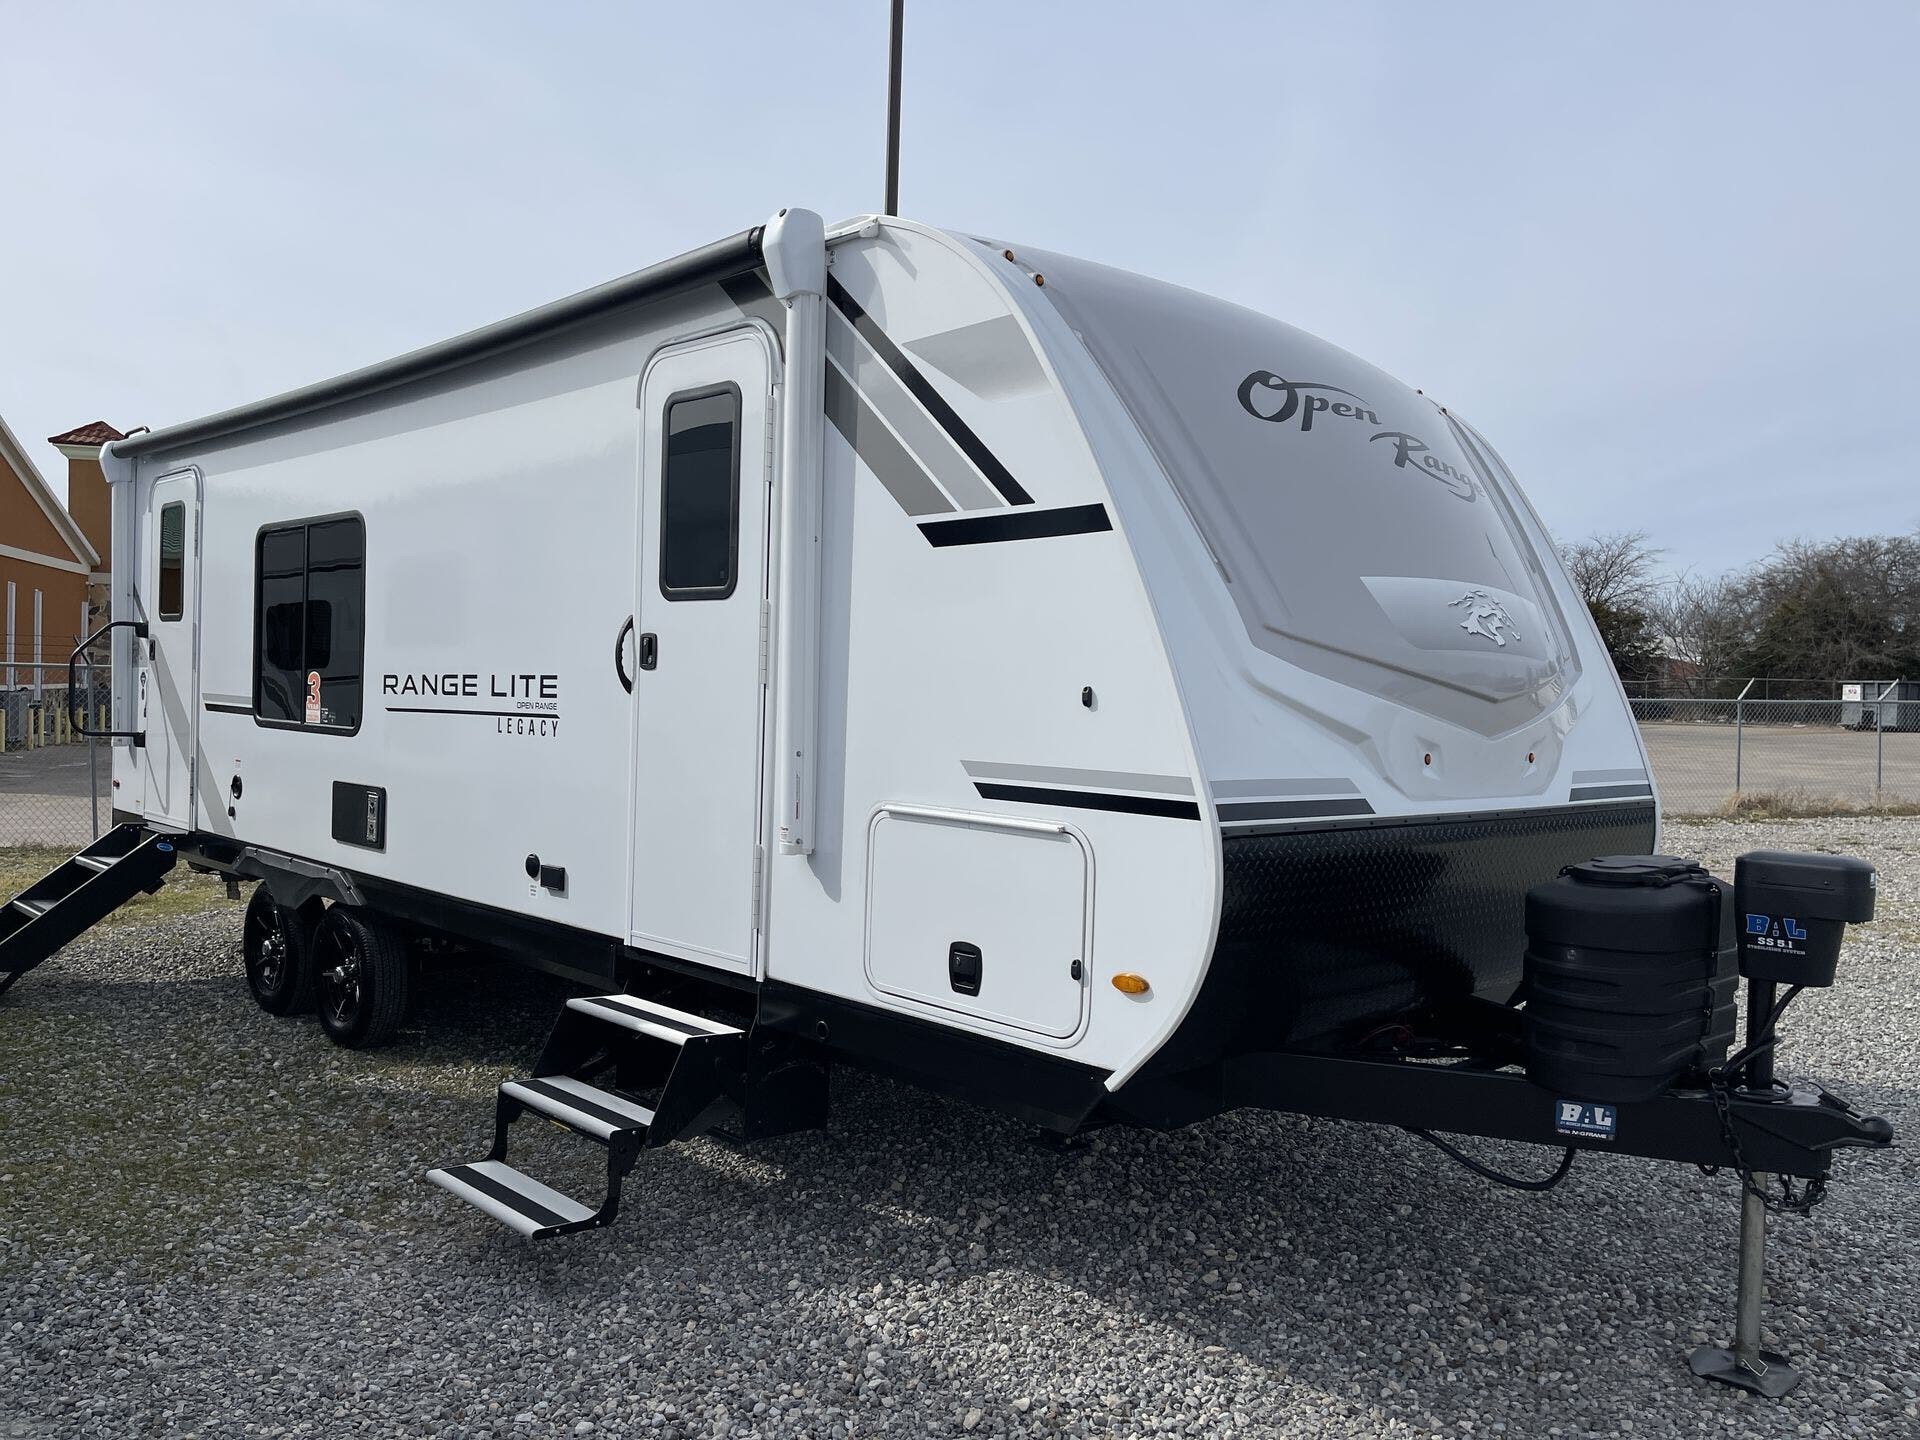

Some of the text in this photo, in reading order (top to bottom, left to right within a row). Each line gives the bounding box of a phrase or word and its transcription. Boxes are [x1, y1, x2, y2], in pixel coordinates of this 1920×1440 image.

[1237, 370, 1382, 431] Open
[307, 671, 321, 704] 3
[383, 674, 558, 698] RANGE LITE
[517, 701, 557, 710] OPEN RANGE
[498, 717, 558, 738] LEGACY
[1746, 914, 1806, 940] BAL
[1757, 937, 1775, 946] SS
[1561, 1103, 1612, 1126] BAL
